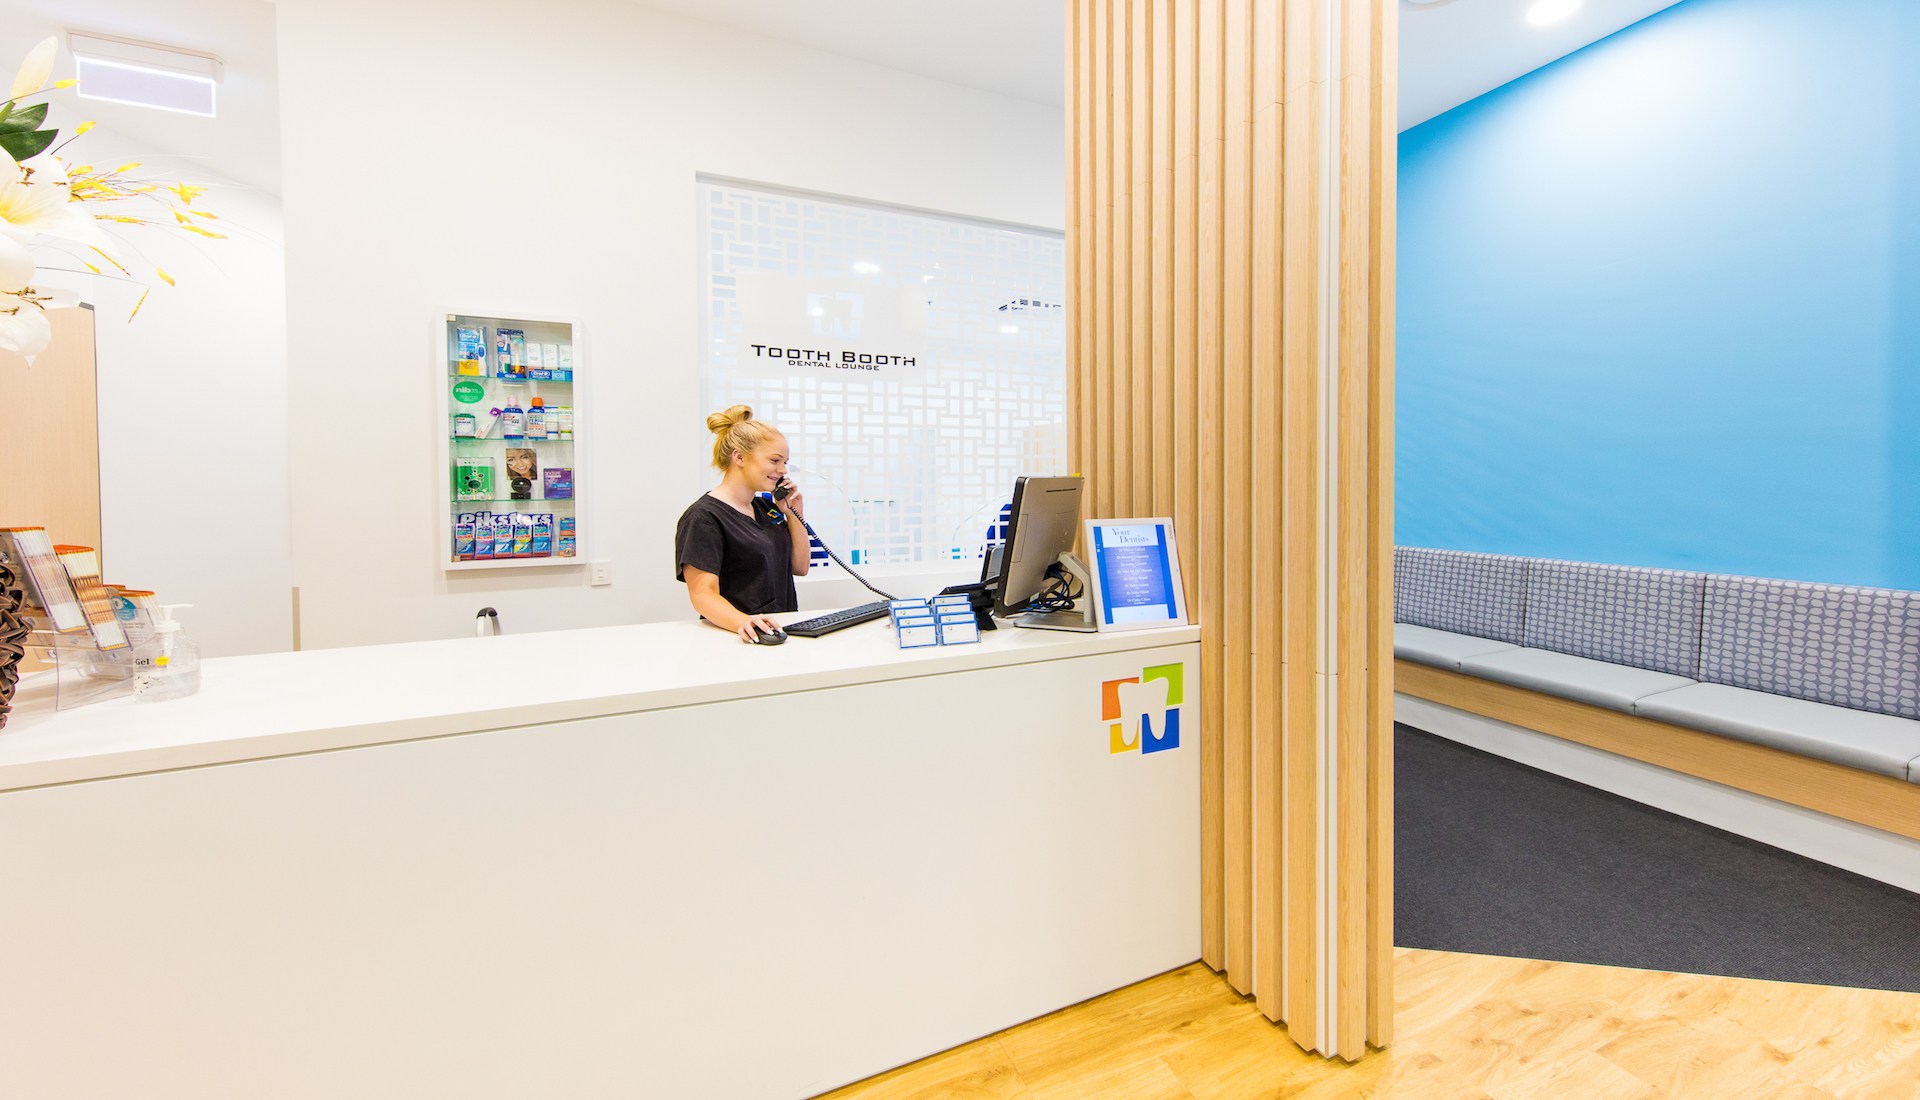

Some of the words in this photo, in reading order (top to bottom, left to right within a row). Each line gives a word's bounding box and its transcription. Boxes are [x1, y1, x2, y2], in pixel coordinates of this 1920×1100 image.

[751, 344, 830, 361] TOOTH
[842, 351, 916, 367] BOOTH
[788, 360, 831, 368] DENTAL
[835, 363, 880, 371] LOUNGE
